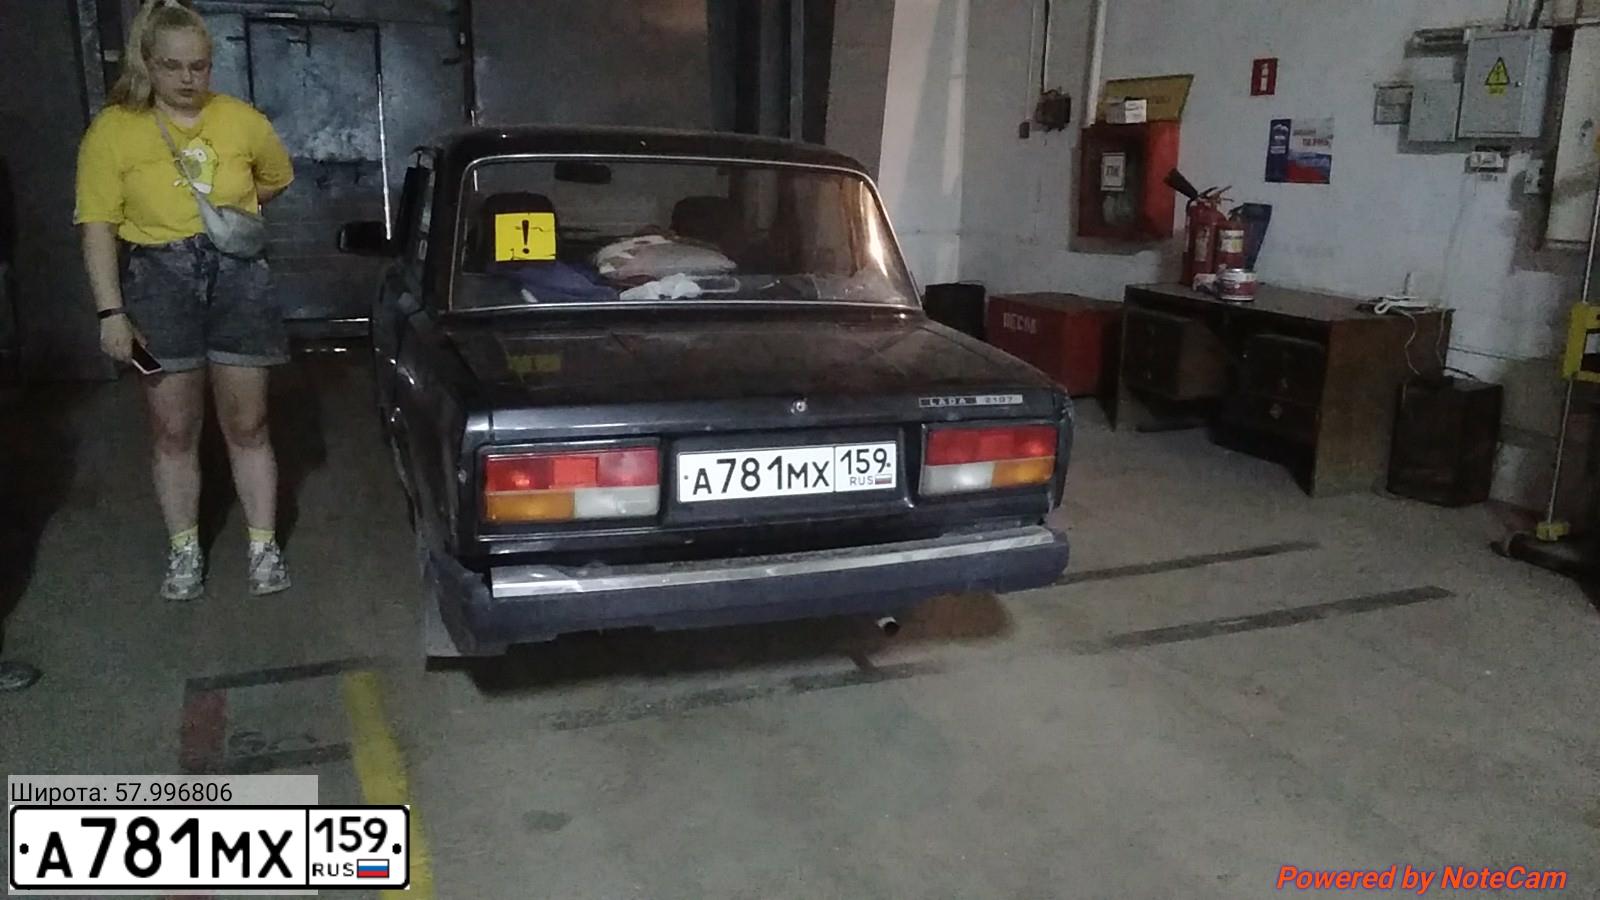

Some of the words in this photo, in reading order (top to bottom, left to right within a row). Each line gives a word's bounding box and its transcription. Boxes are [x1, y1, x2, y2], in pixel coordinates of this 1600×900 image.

[930, 397, 966, 406] LADA
[985, 396, 1013, 404] 2107
[692, 455, 831, 496] А781МХ
[840, 447, 887, 475] 159
[850, 475, 874, 486] RUS
